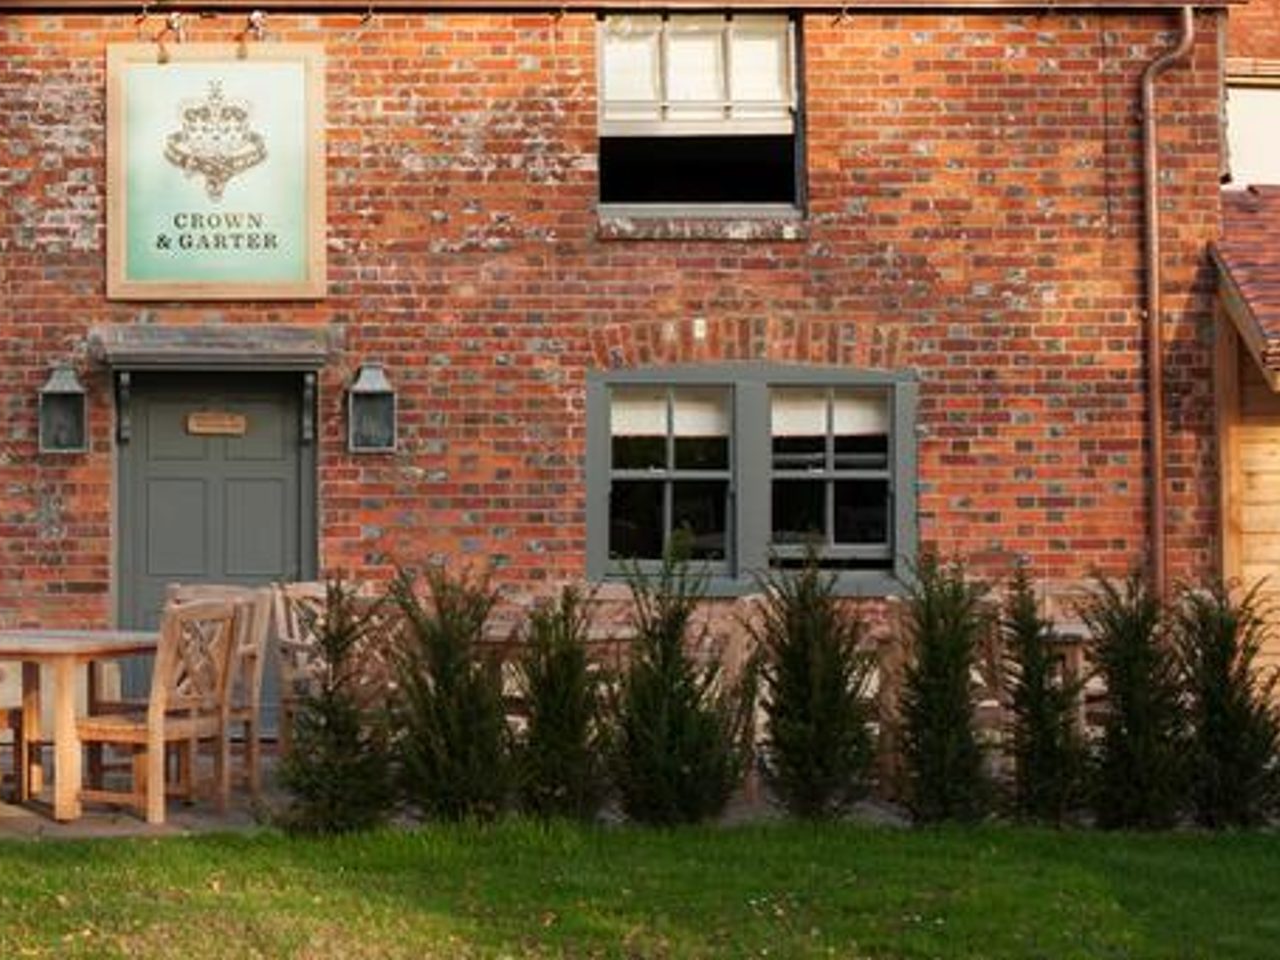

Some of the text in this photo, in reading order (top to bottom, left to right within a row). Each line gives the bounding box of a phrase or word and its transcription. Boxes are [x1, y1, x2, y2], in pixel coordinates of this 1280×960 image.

[173, 213, 263, 229] CROWN
[156, 233, 279, 250] & GARTER
